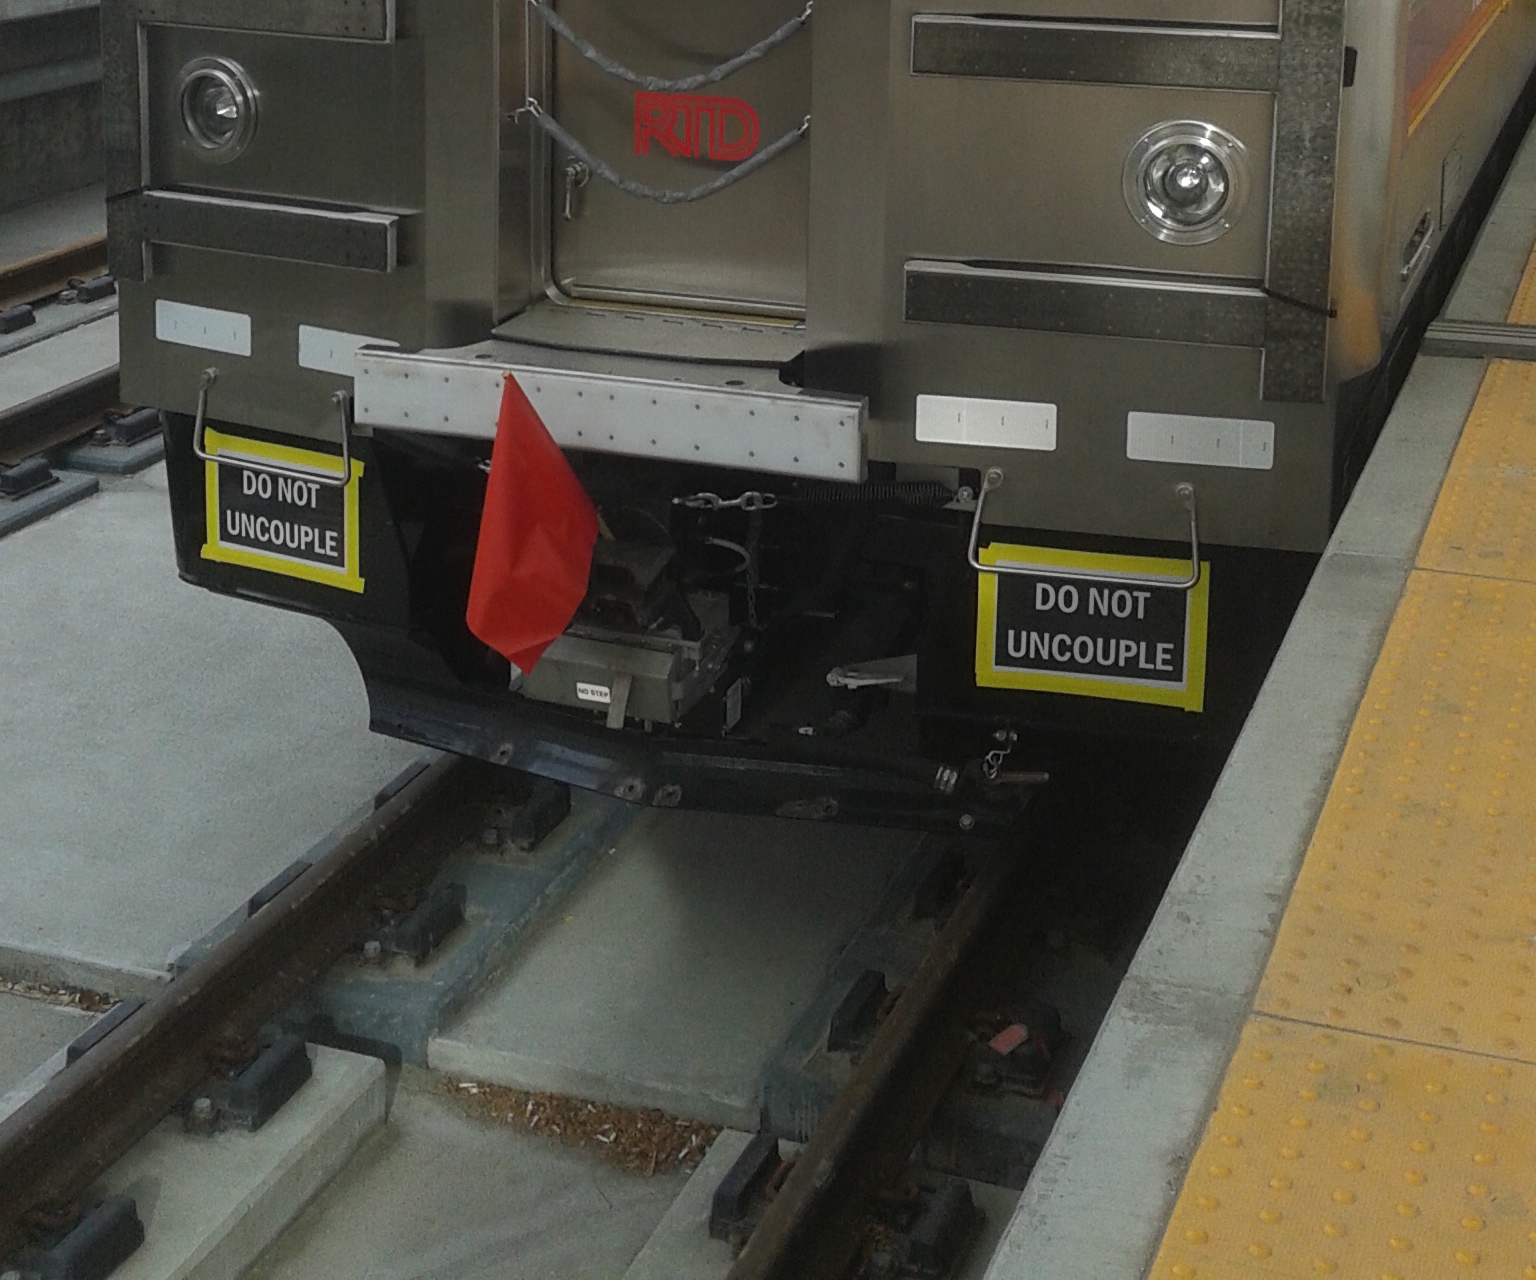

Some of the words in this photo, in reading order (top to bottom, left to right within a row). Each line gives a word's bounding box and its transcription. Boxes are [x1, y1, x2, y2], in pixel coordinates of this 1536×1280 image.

[634, 91, 760, 162] RTD
[243, 470, 272, 499] DO
[278, 477, 320, 508] NOT
[226, 509, 338, 557] UNCOUPLE
[1035, 582, 1079, 613] DO
[1088, 587, 1151, 620] NOT
[1007, 629, 1174, 671] UNCOUPLE
[578, 688, 589, 696] NO
[590, 689, 609, 698] STEP
